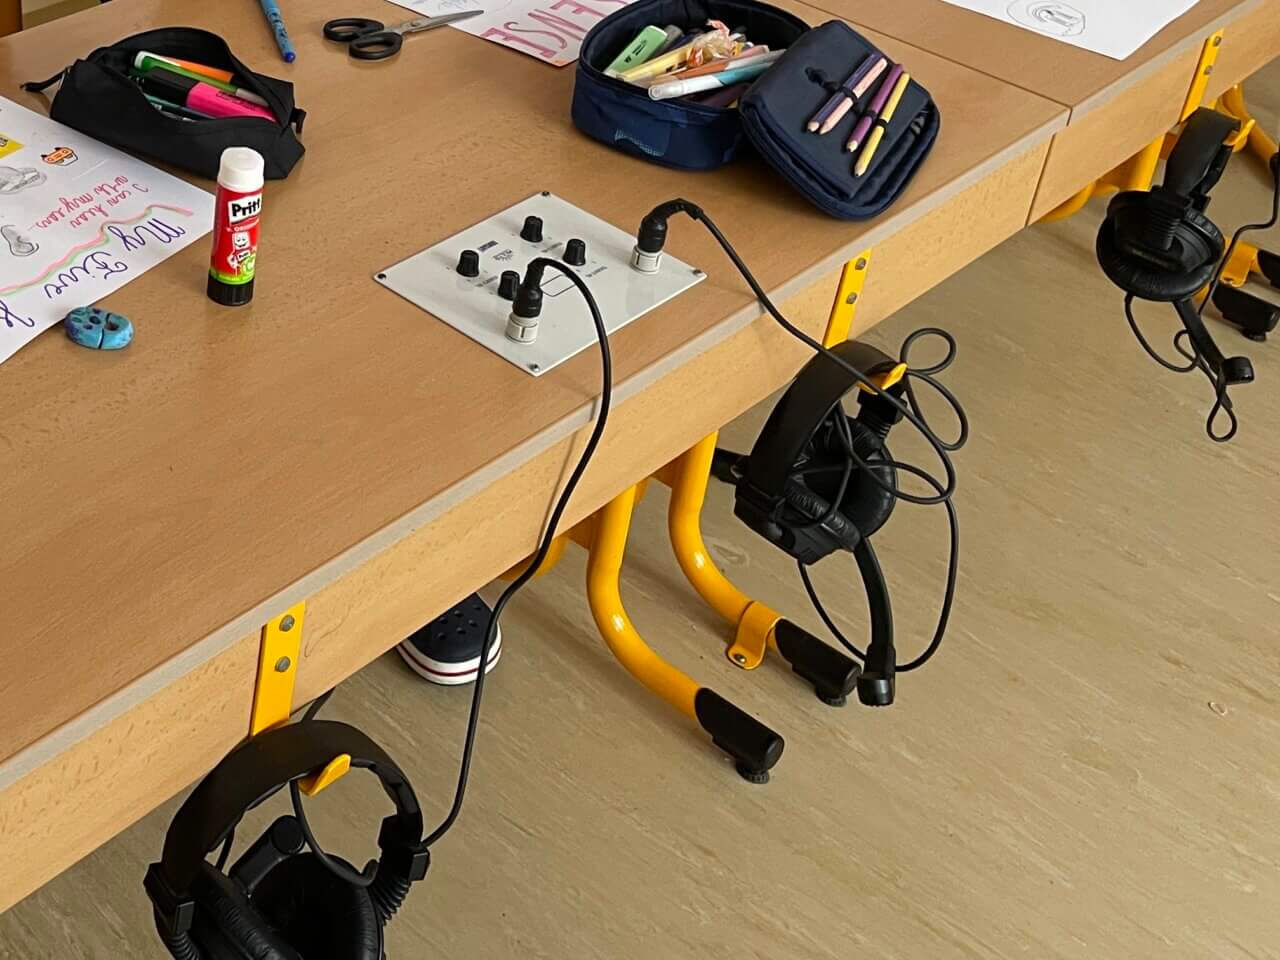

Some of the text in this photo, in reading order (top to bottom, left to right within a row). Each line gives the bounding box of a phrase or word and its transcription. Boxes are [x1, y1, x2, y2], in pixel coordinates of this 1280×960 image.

[106, 190, 133, 207] can
[106, 217, 187, 252] My
[43, 250, 129, 299] Five
